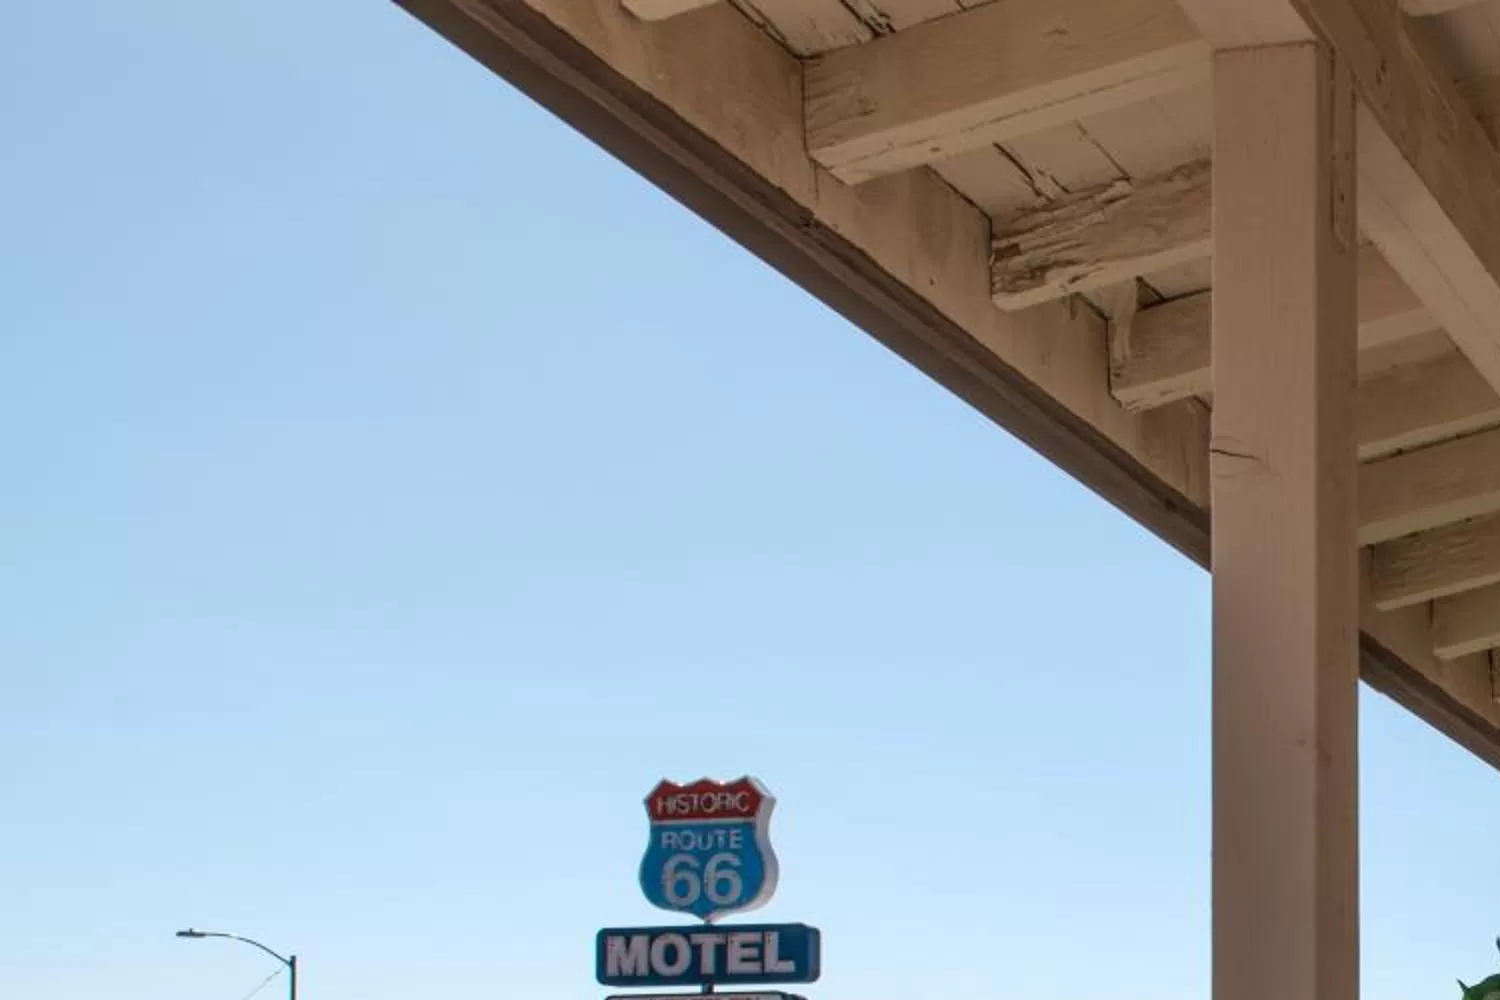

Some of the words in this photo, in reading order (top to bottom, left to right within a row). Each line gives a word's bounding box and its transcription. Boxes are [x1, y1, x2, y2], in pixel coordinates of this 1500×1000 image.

[656, 791, 750, 815] HISTORIC
[661, 830, 742, 850] ROUTE
[662, 852, 743, 906] 66
[606, 931, 795, 976] MOTEL
